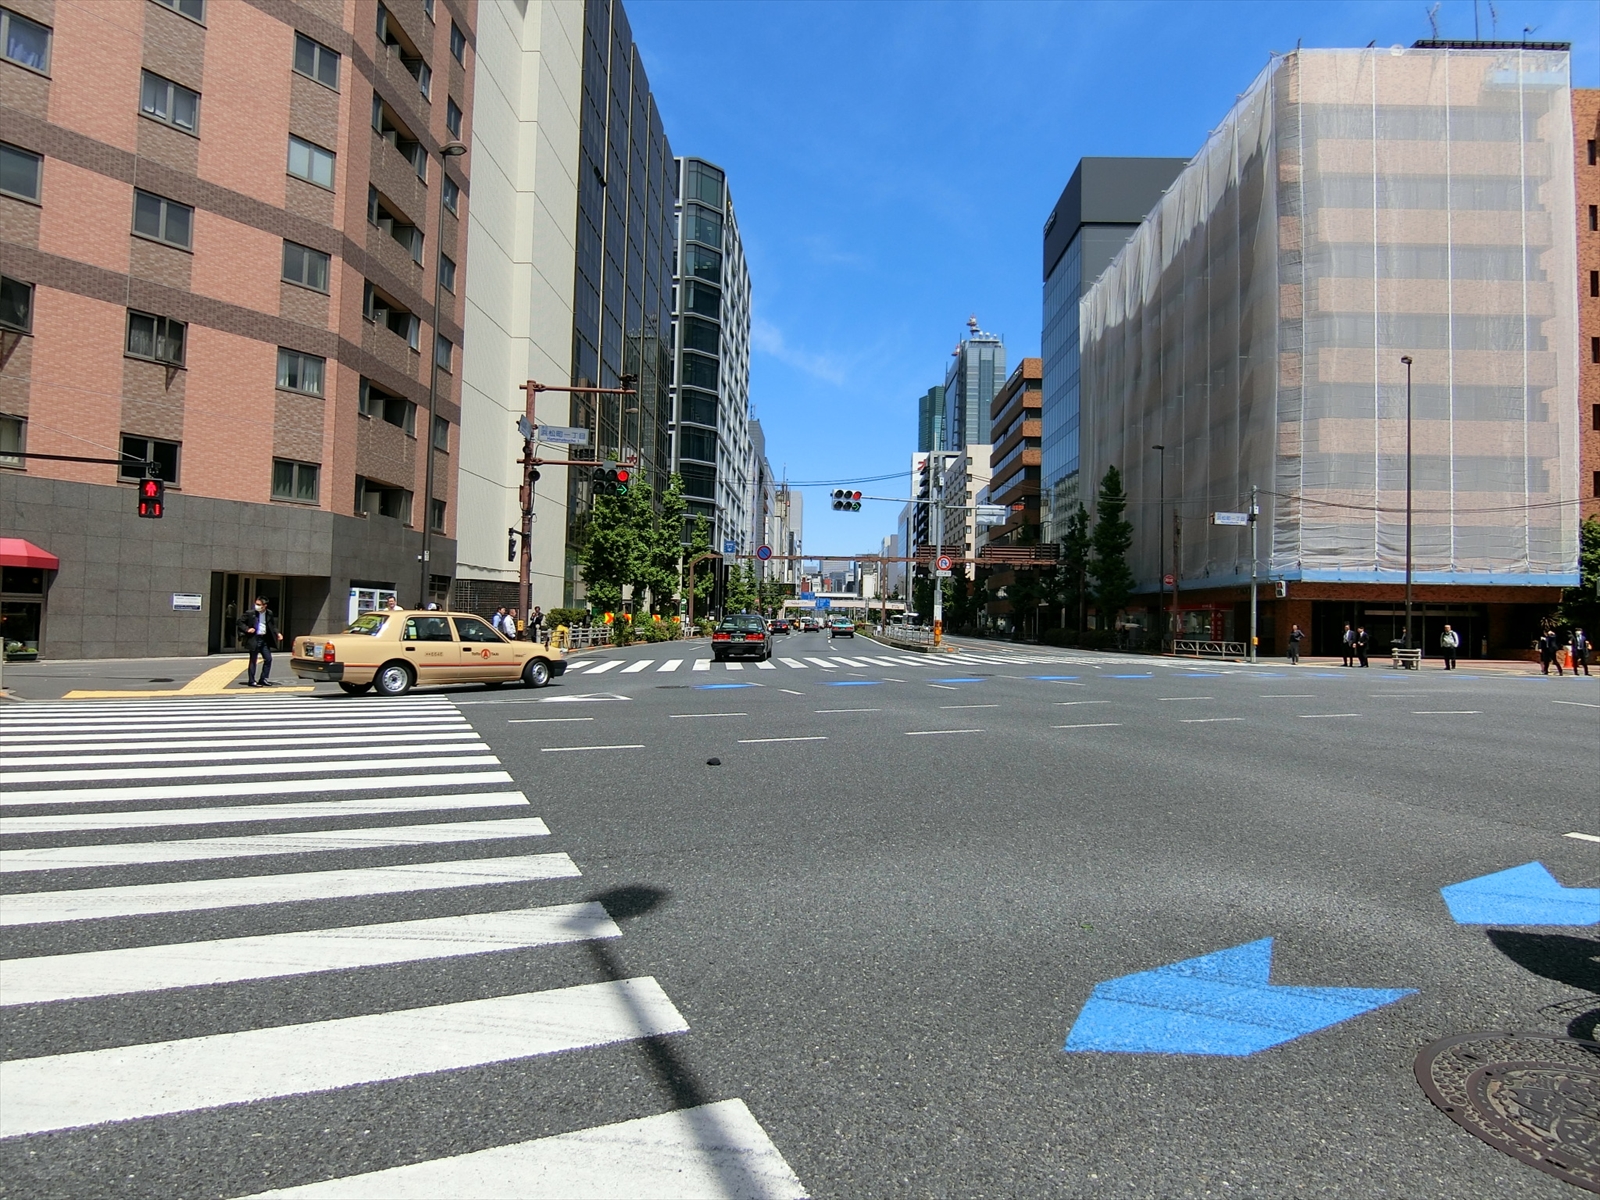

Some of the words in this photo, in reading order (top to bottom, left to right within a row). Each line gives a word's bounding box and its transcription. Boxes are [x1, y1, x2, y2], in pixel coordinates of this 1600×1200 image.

[541, 430, 585, 440] 浜松町一丁目
